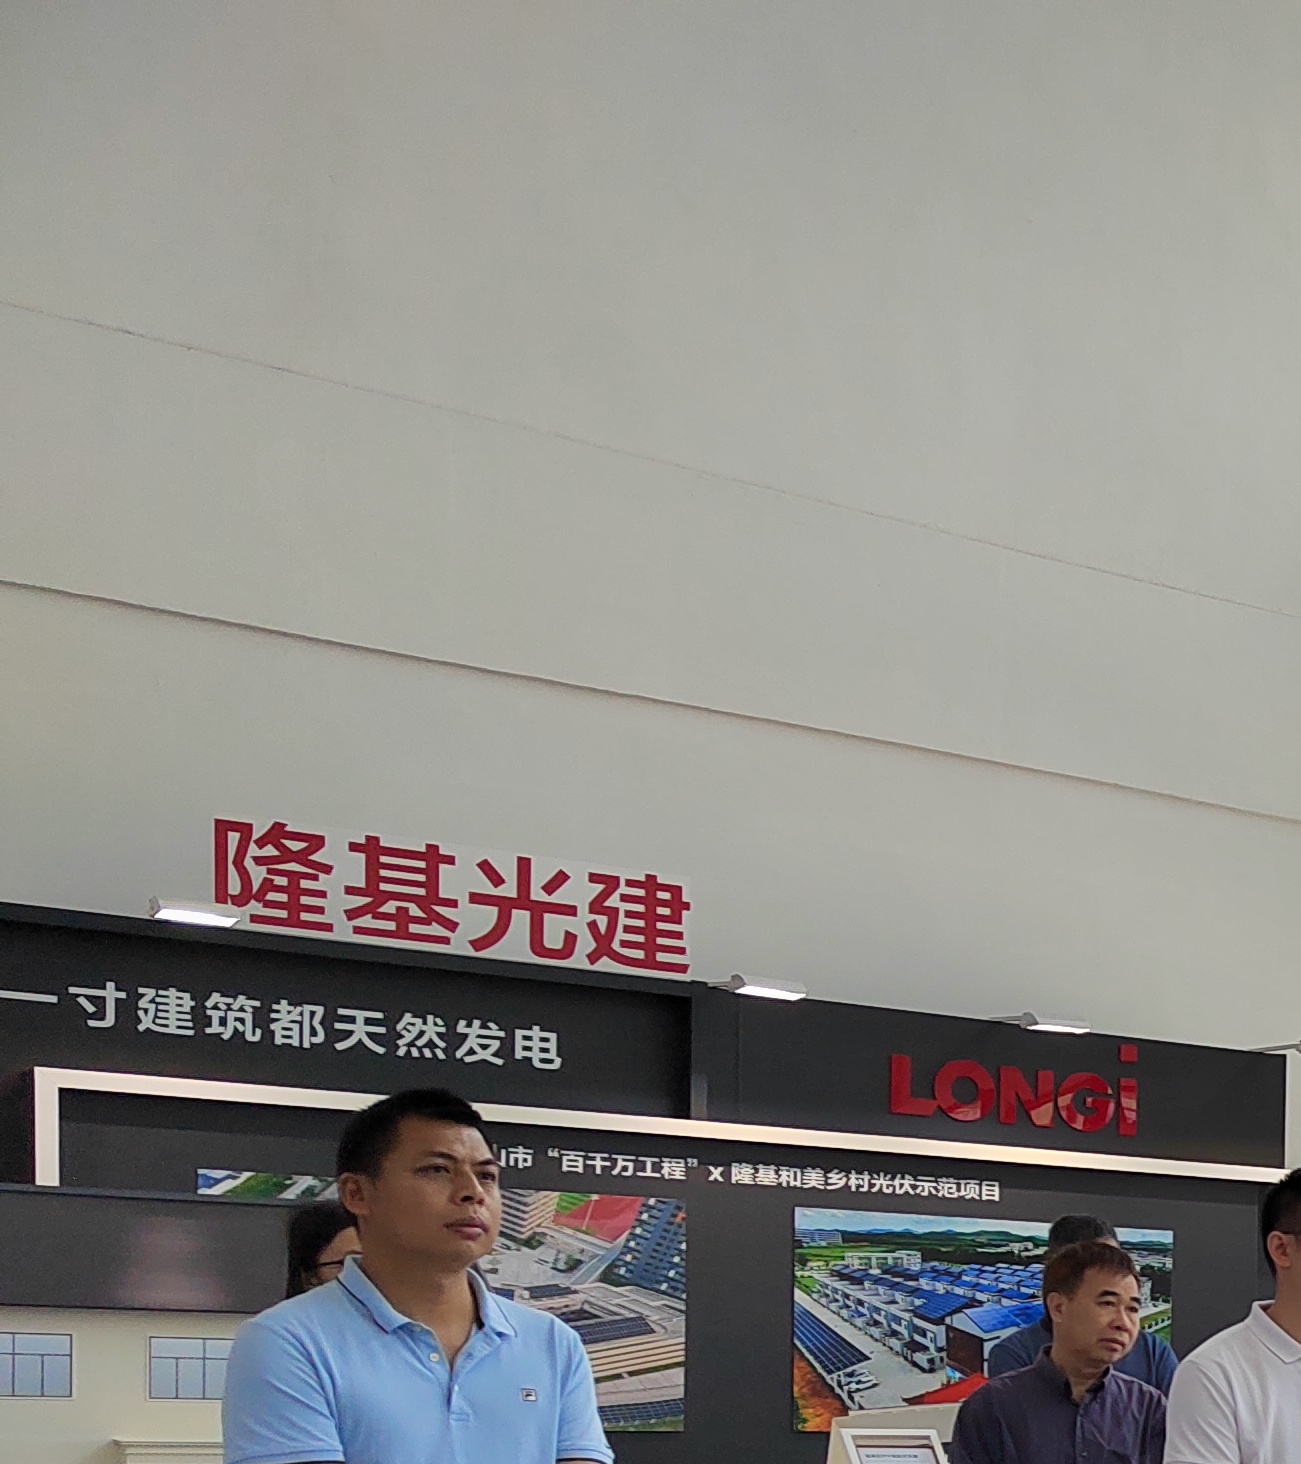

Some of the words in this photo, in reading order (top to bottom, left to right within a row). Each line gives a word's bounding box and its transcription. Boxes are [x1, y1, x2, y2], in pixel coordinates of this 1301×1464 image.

[213, 817, 692, 975] 隆基光建
[0, 980, 563, 1071] 一寸建筑都天然发电
[889, 1043, 1138, 1137] LONGi
[730, 1162, 1001, 1202] 隆基和美乡村光伏示范项目
